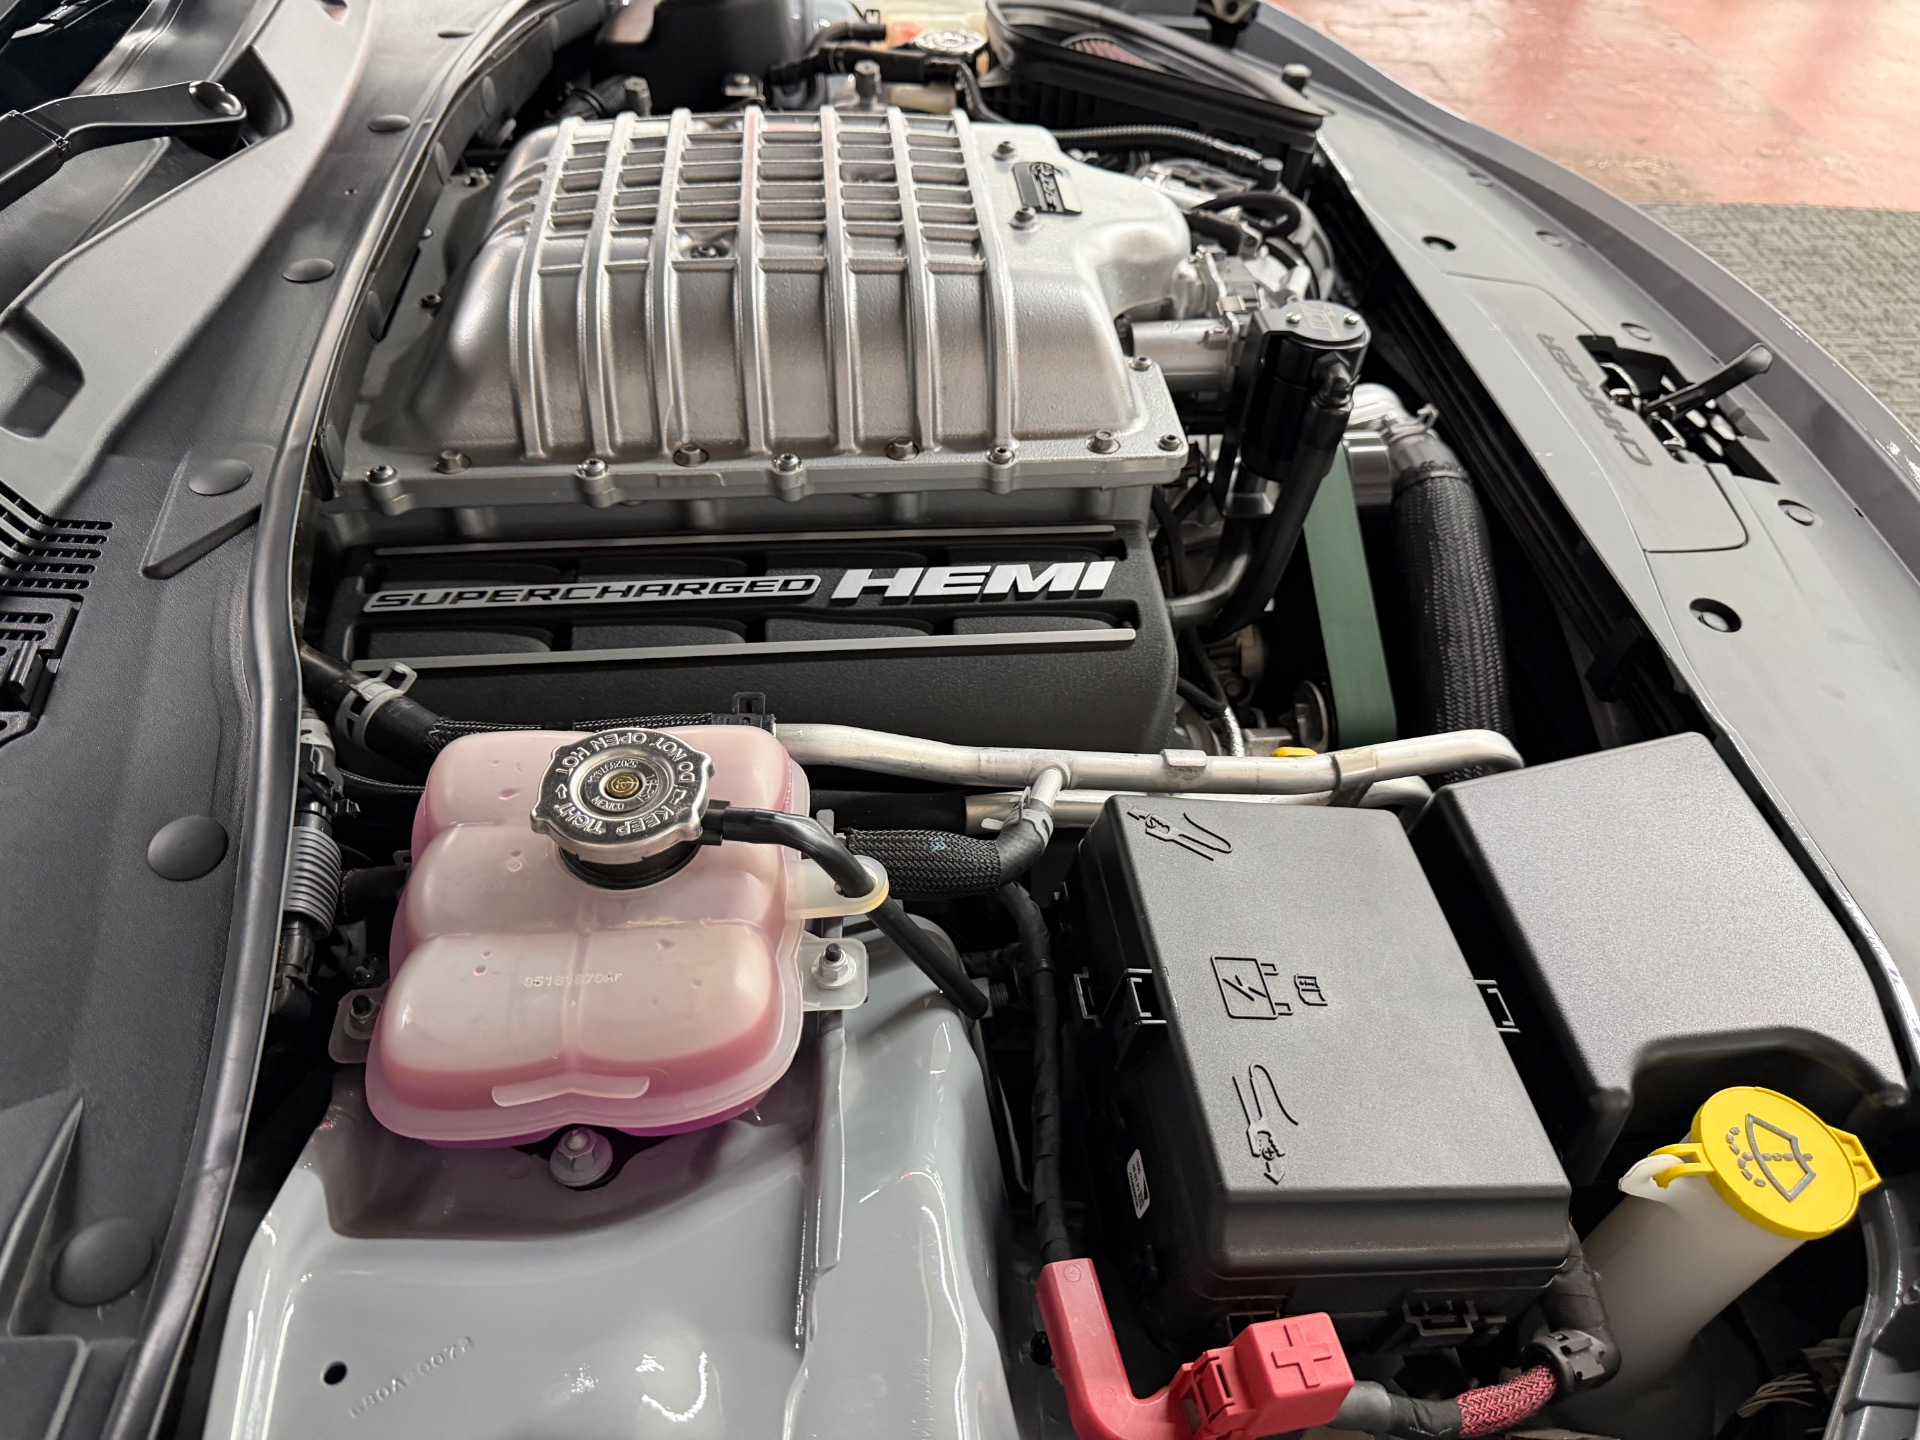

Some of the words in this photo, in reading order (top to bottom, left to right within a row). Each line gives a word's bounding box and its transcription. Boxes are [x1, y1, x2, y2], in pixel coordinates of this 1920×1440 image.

[1537, 333, 1653, 466] CHARGER
[379, 577, 818, 609] SUPERCHARGED
[831, 560, 1116, 600] HEMI
[590, 732, 648, 751] OPEN
[649, 736, 688, 762] NOT
[556, 745, 593, 776] HOT
[678, 761, 696, 783] DO
[553, 802, 607, 835] TIGHT
[591, 795, 625, 811] MEXICO
[616, 805, 675, 837] KEEP
